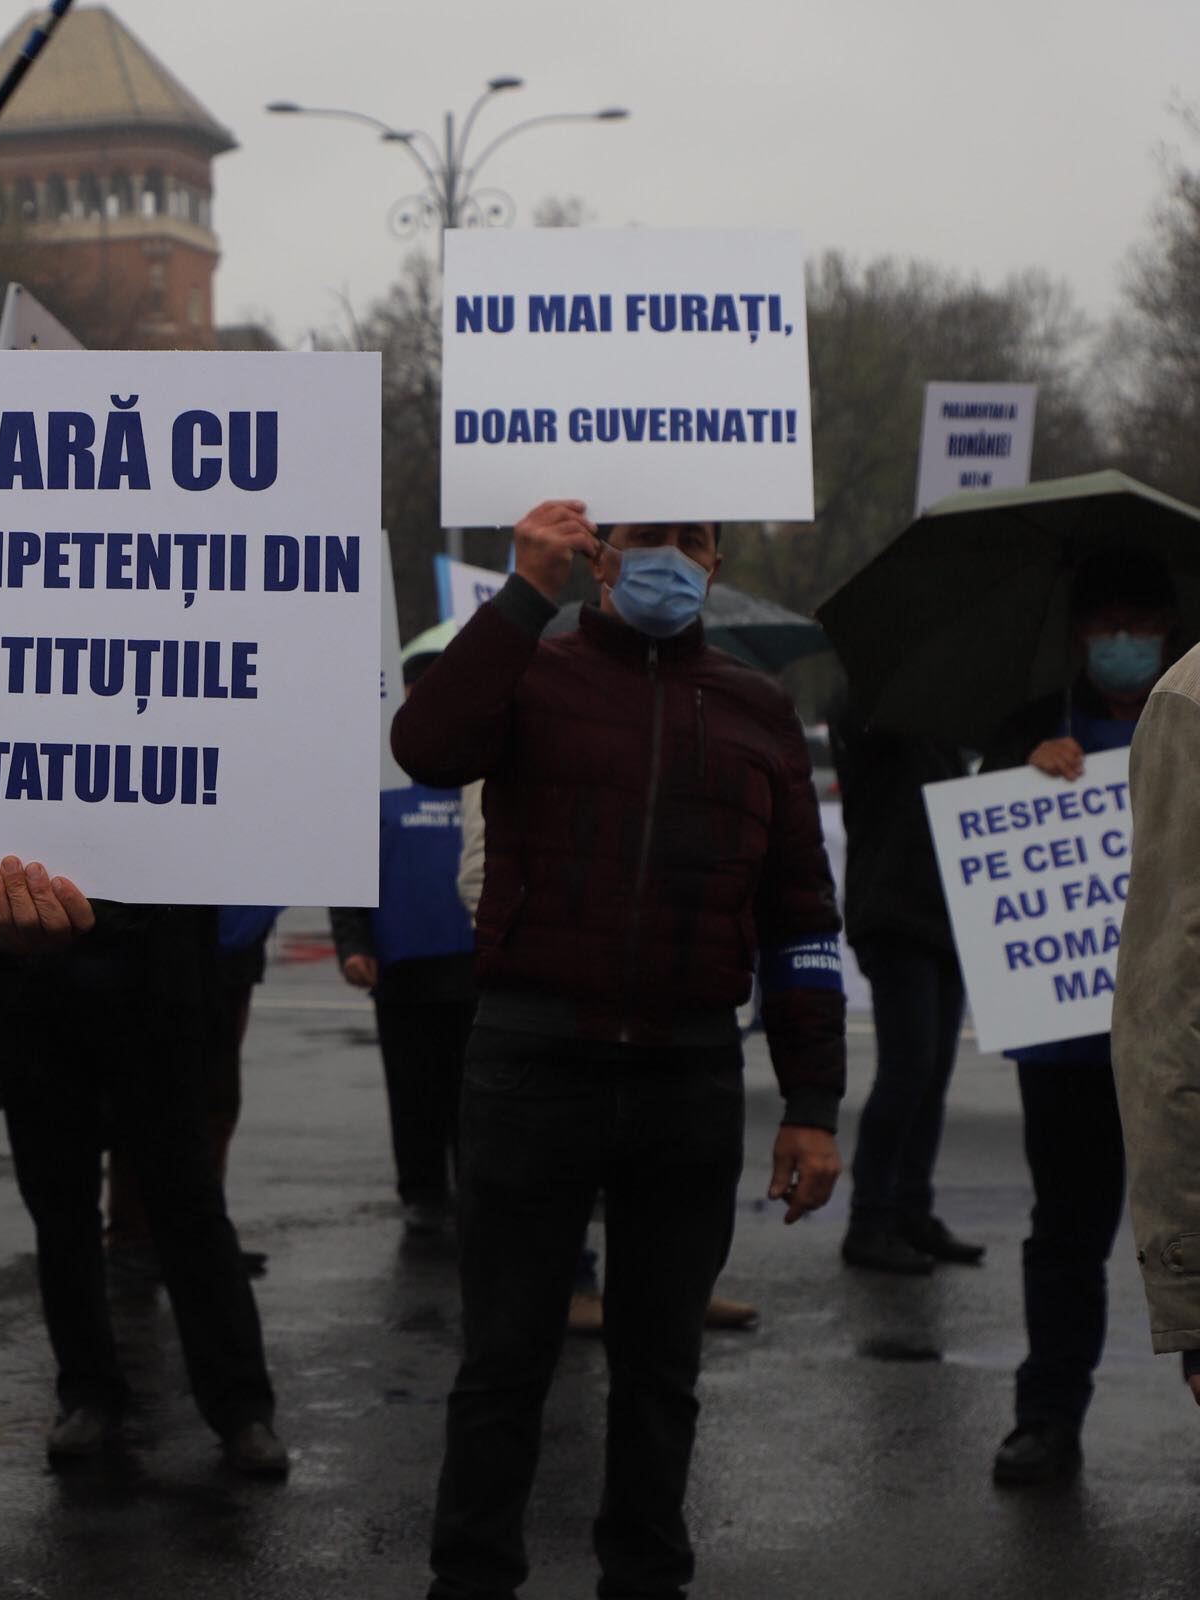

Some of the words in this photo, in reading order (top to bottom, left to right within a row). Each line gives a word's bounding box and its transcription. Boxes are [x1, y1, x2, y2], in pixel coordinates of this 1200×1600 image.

[455, 294, 515, 334] NU
[528, 294, 613, 333] MAI
[625, 293, 793, 344] FURAȚI,
[171, 409, 279, 492] CU
[454, 408, 558, 445] DOAR
[568, 407, 797, 444] GUVERNATI!
[263, 534, 361, 593] DIN
[958, 783, 1128, 840] RESPECT
[959, 851, 1011, 886] PE
[1023, 836, 1088, 874] CEI
[994, 889, 1048, 925] AU
[1053, 967, 1116, 1004] MA
